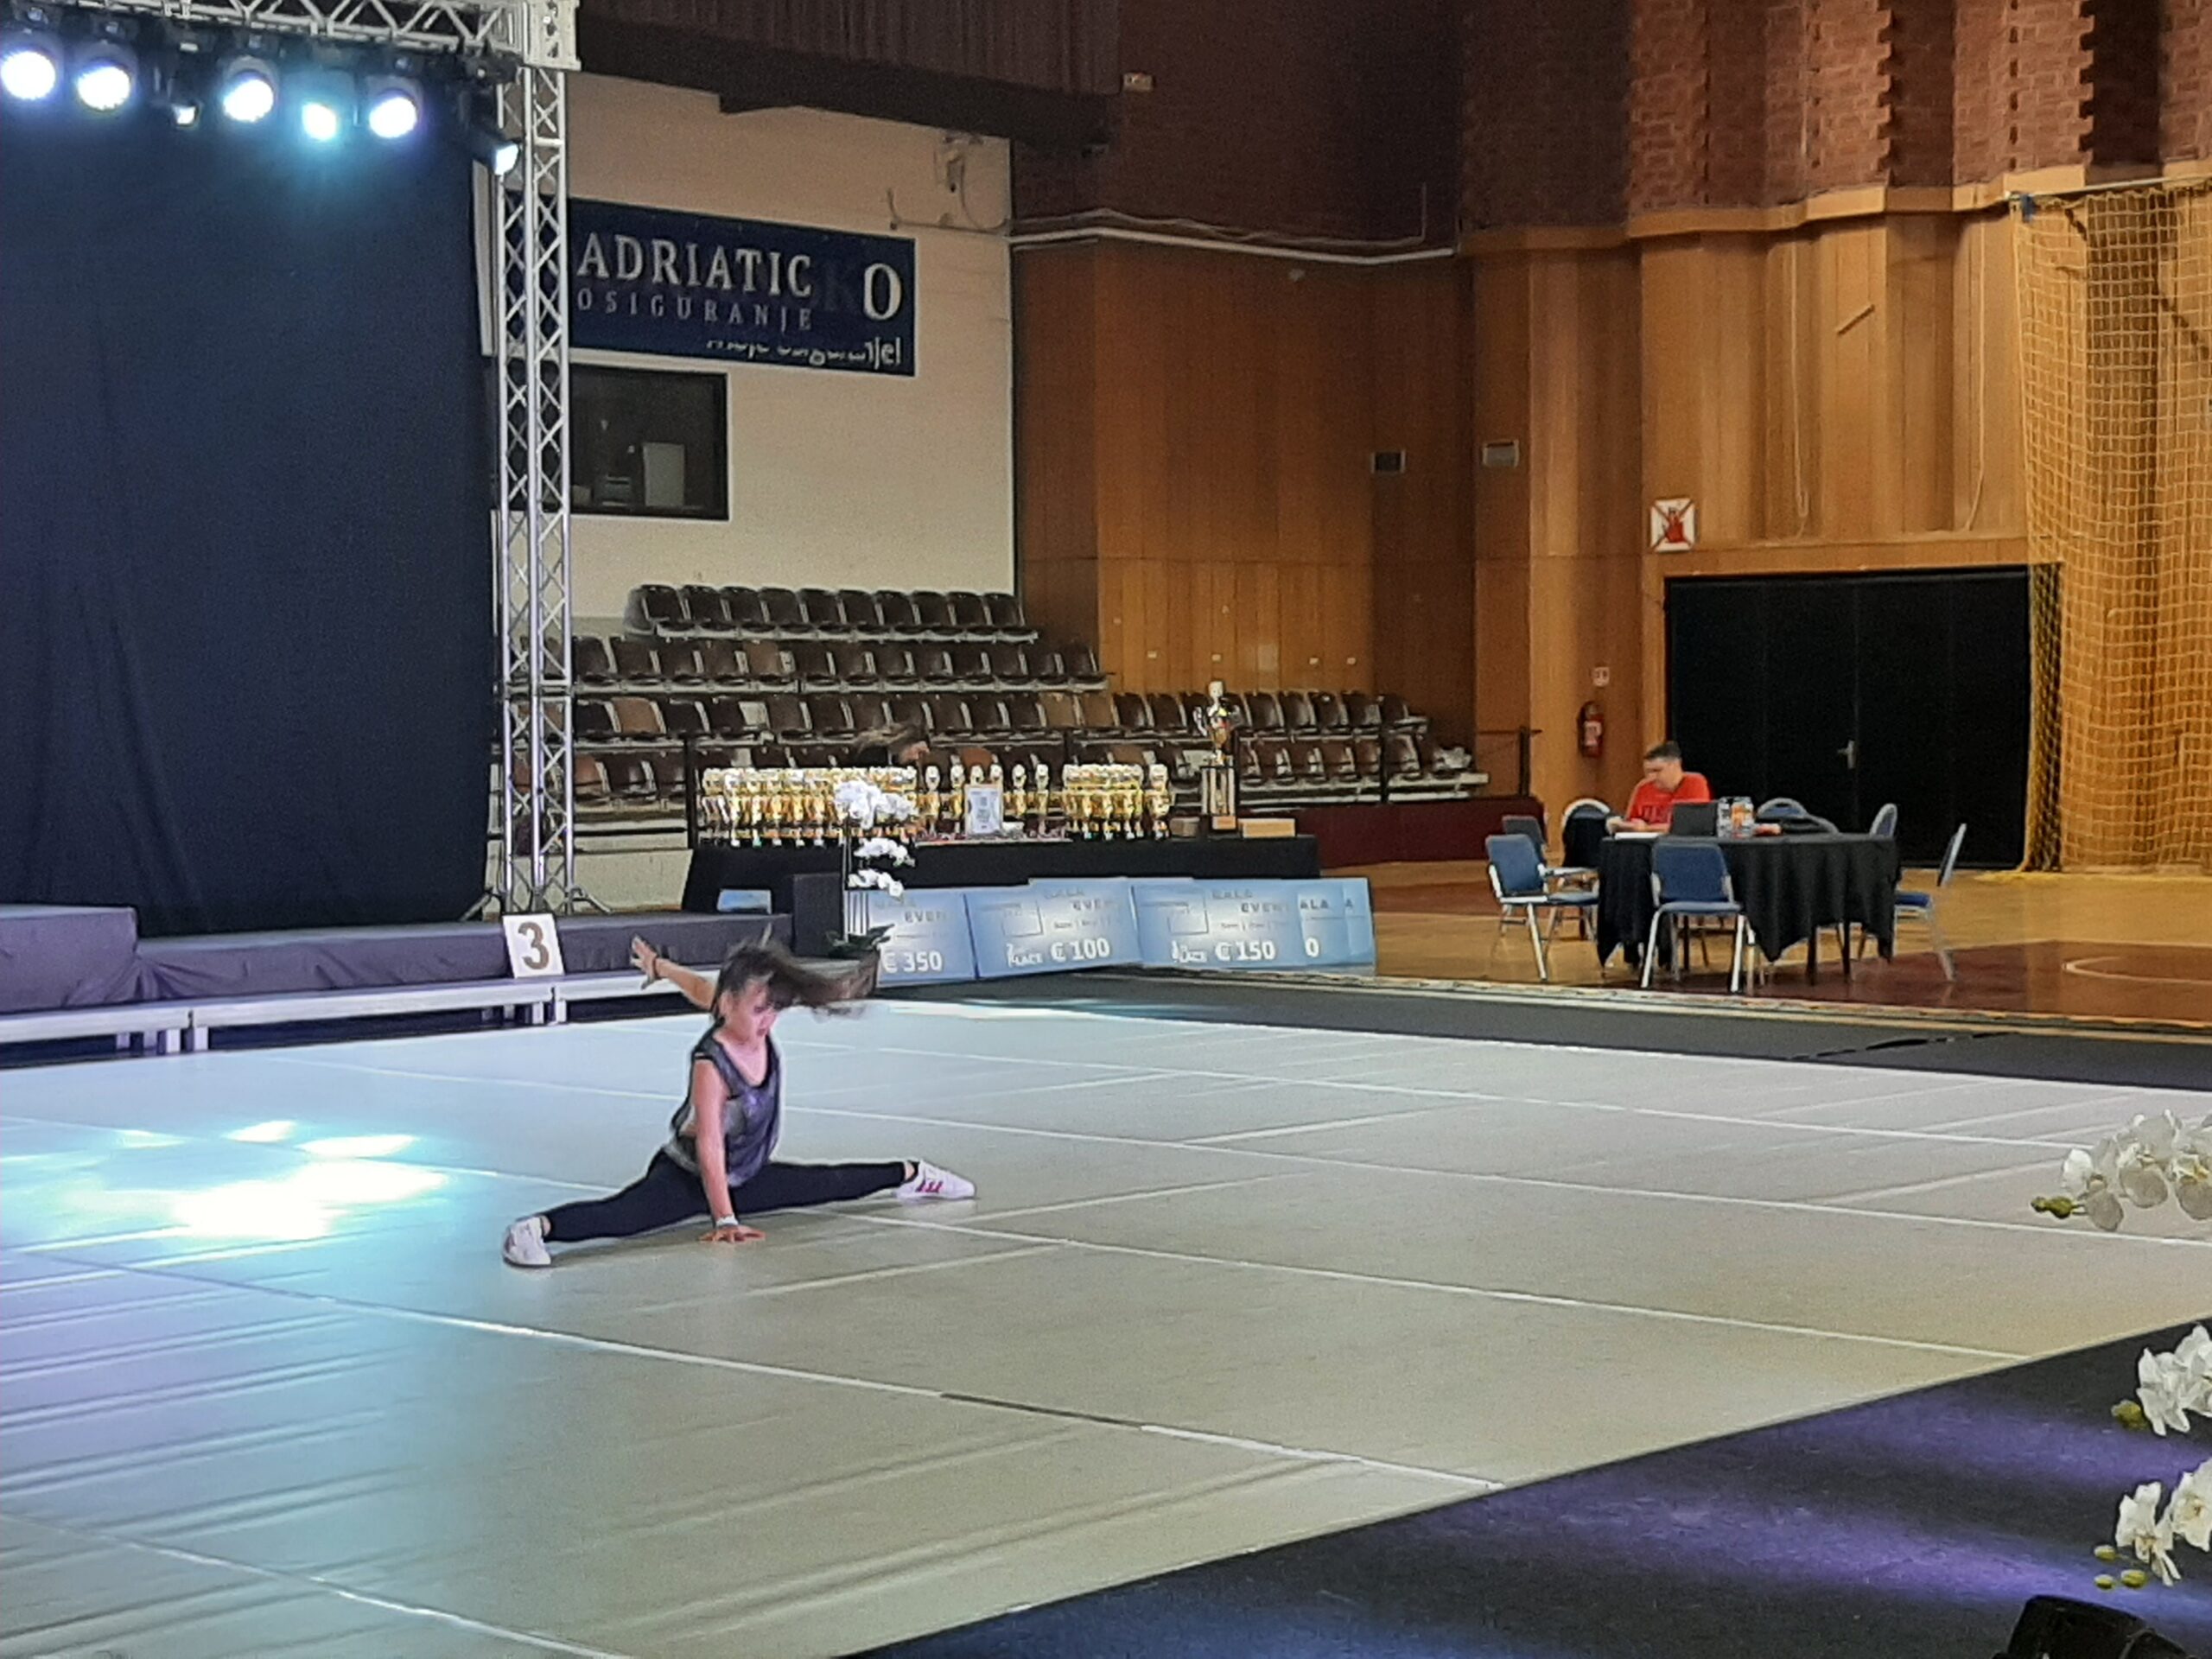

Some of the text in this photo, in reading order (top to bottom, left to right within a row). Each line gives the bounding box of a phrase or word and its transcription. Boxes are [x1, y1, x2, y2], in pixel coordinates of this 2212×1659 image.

[576, 231, 811, 298] ADRIATIC
[577, 288, 811, 332] OSIGURANJE
[517, 921, 550, 970] 3
[902, 950, 944, 973] 350
[1068, 937, 1111, 962] 100
[1233, 939, 1276, 962] 150
